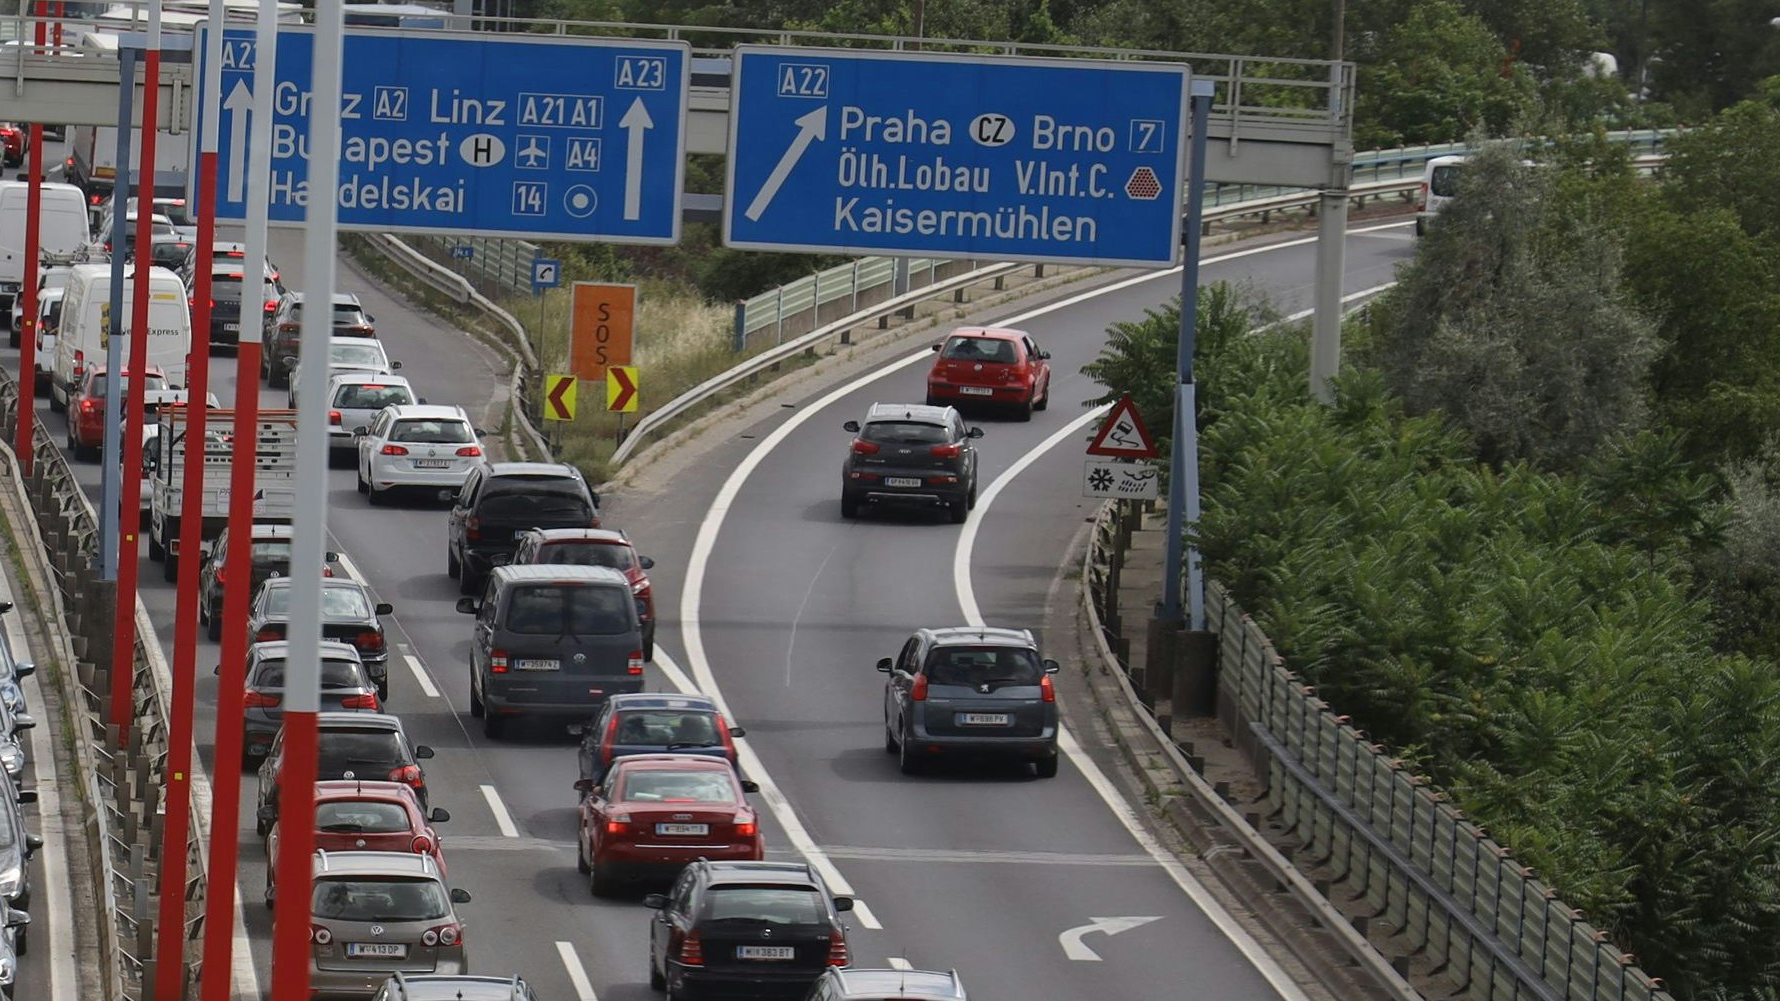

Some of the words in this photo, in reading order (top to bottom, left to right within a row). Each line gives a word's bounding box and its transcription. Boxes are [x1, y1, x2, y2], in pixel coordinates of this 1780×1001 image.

[221, 41, 257, 69] A2
[618, 59, 663, 88] A23
[274, 81, 362, 119] Grz
[376, 89, 405, 118] A2
[430, 88, 506, 125] Linz
[522, 95, 564, 125] A21
[570, 97, 597, 126] A1
[780, 66, 827, 95] A22
[272, 124, 449, 171] Buapest
[474, 137, 491, 163] H
[568, 141, 597, 168] A4
[840, 105, 952, 145] Praha
[978, 116, 1007, 144] CZ
[1032, 114, 1116, 153] Brno
[1138, 123, 1156, 150] 7
[270, 169, 465, 213] Hadelskai
[516, 185, 542, 212] 14
[838, 146, 990, 193] Ölh.Lobau
[1015, 160, 1114, 199] V.Int.C.
[833, 196, 1097, 243] Kaisermühlen
[595, 302, 611, 366] SOS
